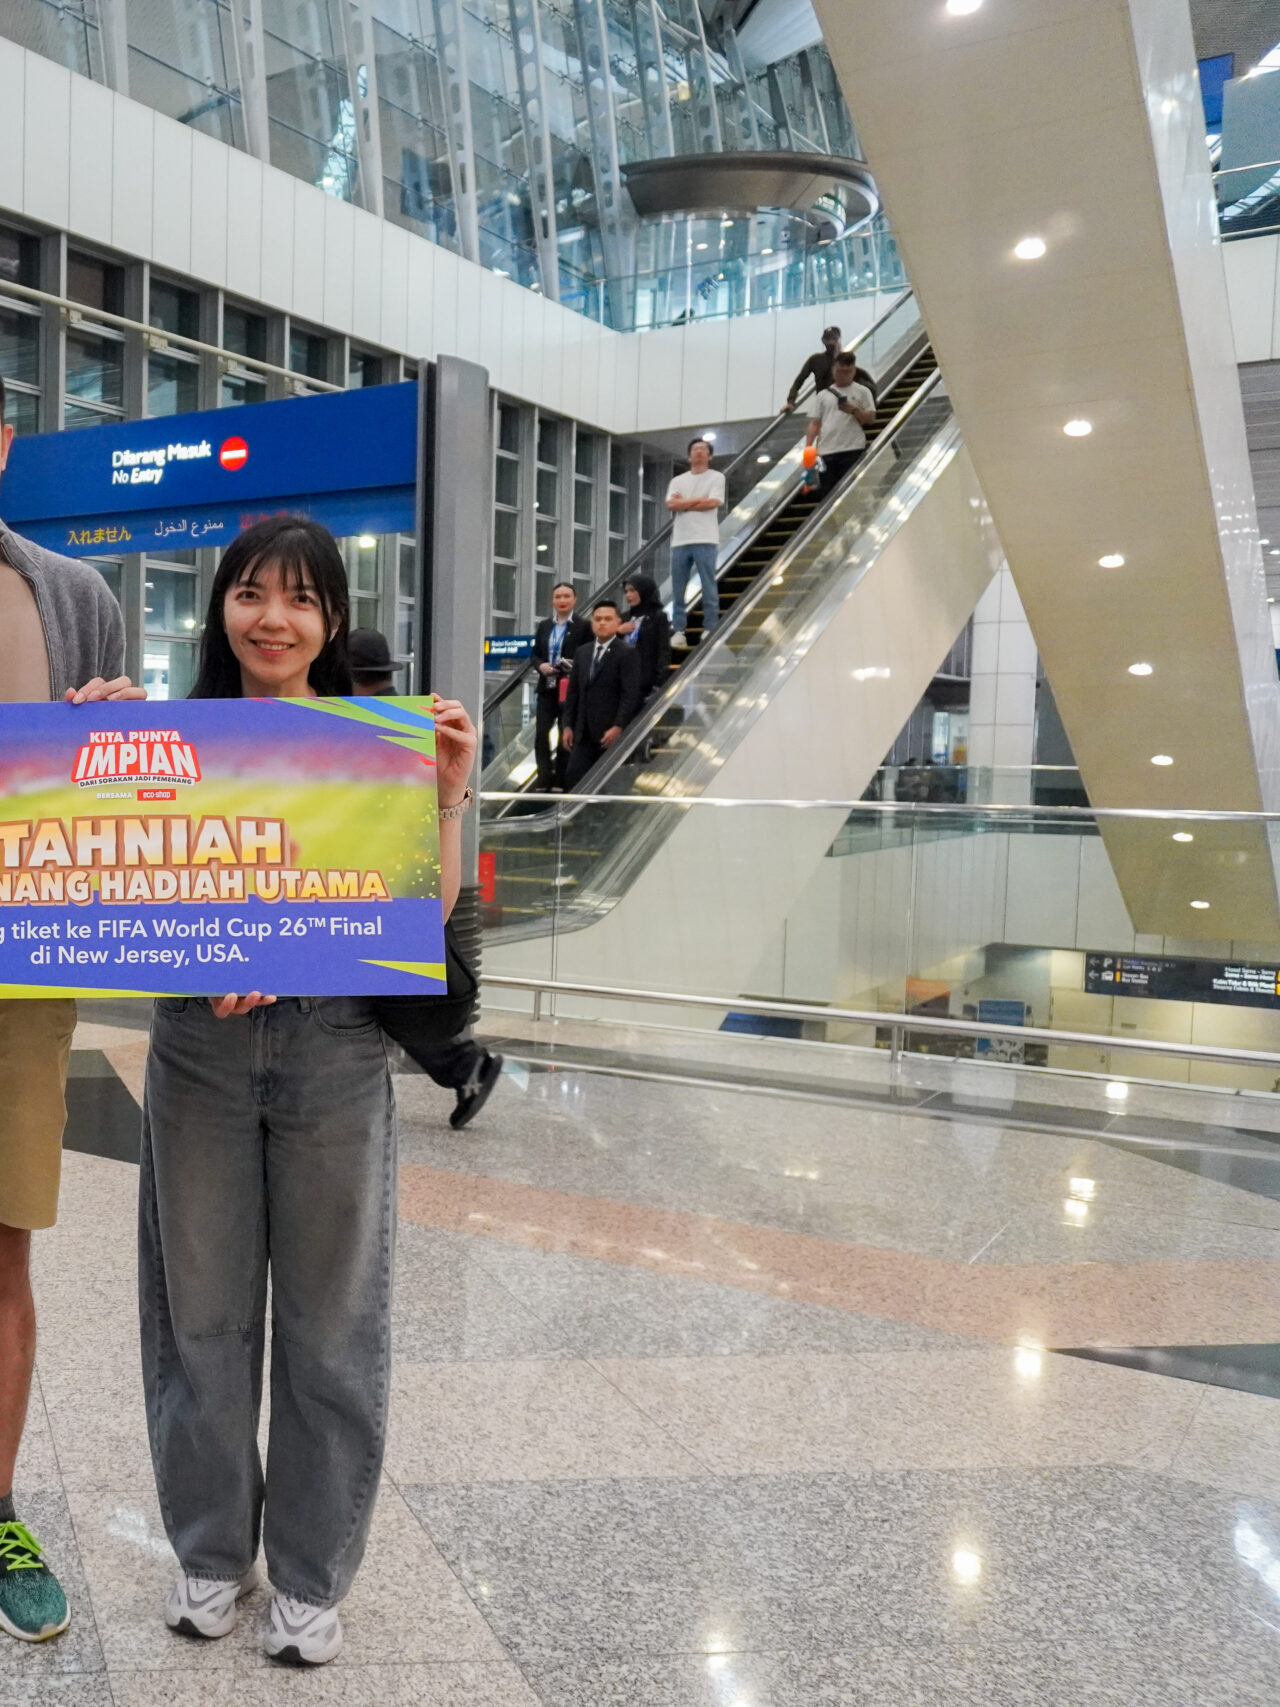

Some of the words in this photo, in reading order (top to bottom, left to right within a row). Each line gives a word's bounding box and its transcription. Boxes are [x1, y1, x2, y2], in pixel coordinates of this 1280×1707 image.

[112, 450, 165, 467] Dilarang
[168, 440, 211, 461] Masuk
[112, 470, 128, 484] No
[130, 468, 163, 485] Entry
[67, 526, 131, 545] 入れません
[154, 519, 186, 536] الدخول
[191, 520, 223, 537] ممنوع
[90, 732, 124, 743] KITA
[129, 730, 181, 742] PUNYA
[75, 743, 198, 779] IMPIAN
[99, 776, 133, 784] SORAKAN
[153, 776, 192, 784] PEMENANG
[99, 869, 247, 901] HADIAH
[255, 869, 388, 900] UTAMA
[12, 920, 60, 940] tiket
[66, 920, 92, 939] ke
[99, 920, 148, 938] FIFA
[152, 918, 220, 938] World
[226, 917, 272, 941] Cup
[330, 916, 382, 936] Final
[30, 945, 50, 964] di
[58, 946, 108, 964] New
[114, 945, 190, 968] Jersey,
[196, 943, 250, 963] USA.
